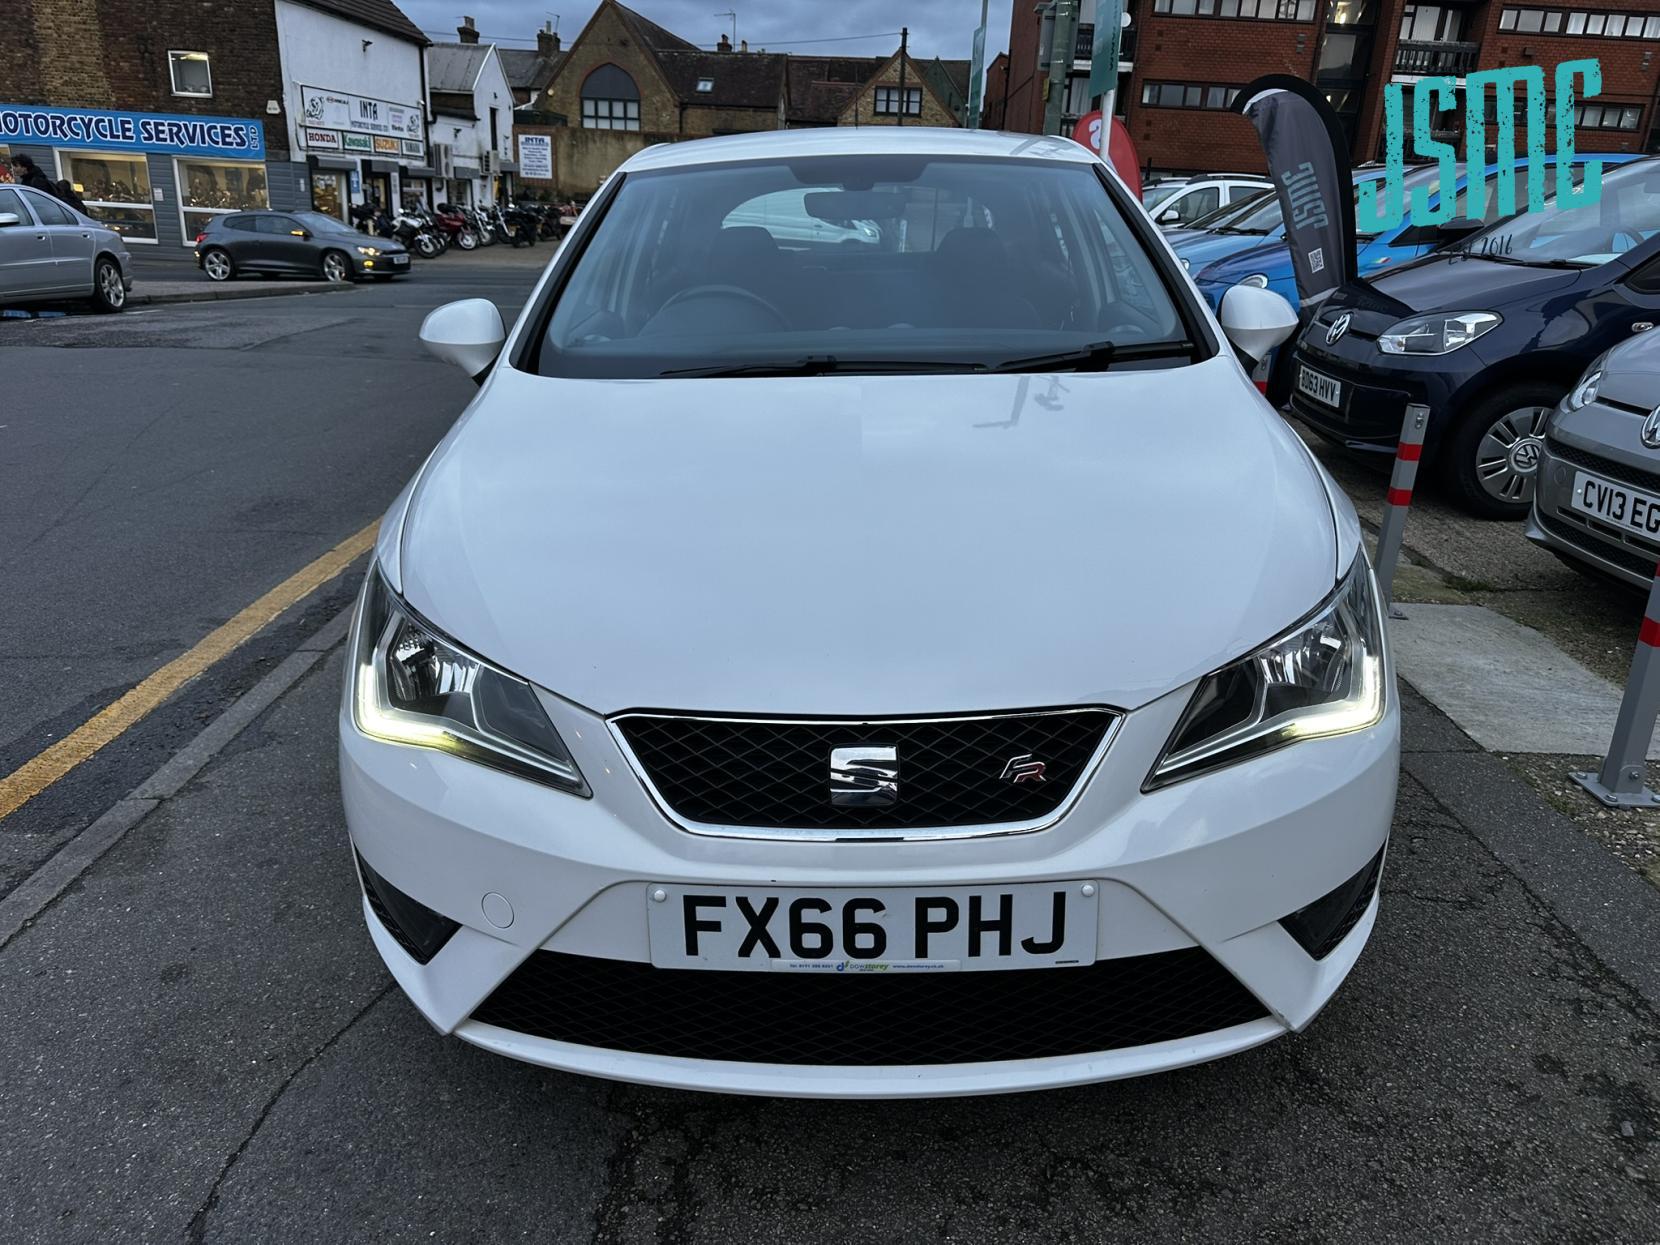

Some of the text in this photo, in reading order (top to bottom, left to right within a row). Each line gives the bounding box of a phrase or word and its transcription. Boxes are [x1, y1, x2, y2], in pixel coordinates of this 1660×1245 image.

[360, 99, 378, 121] INTA
[0, 110, 248, 148] OTORCYCLE SERVICES
[249, 125, 259, 150] LTD
[308, 132, 337, 143] HONDA
[1319, 376, 1337, 402] HVV
[1583, 480, 1627, 521] CV13
[682, 891, 1067, 959] FX66 PHJ
